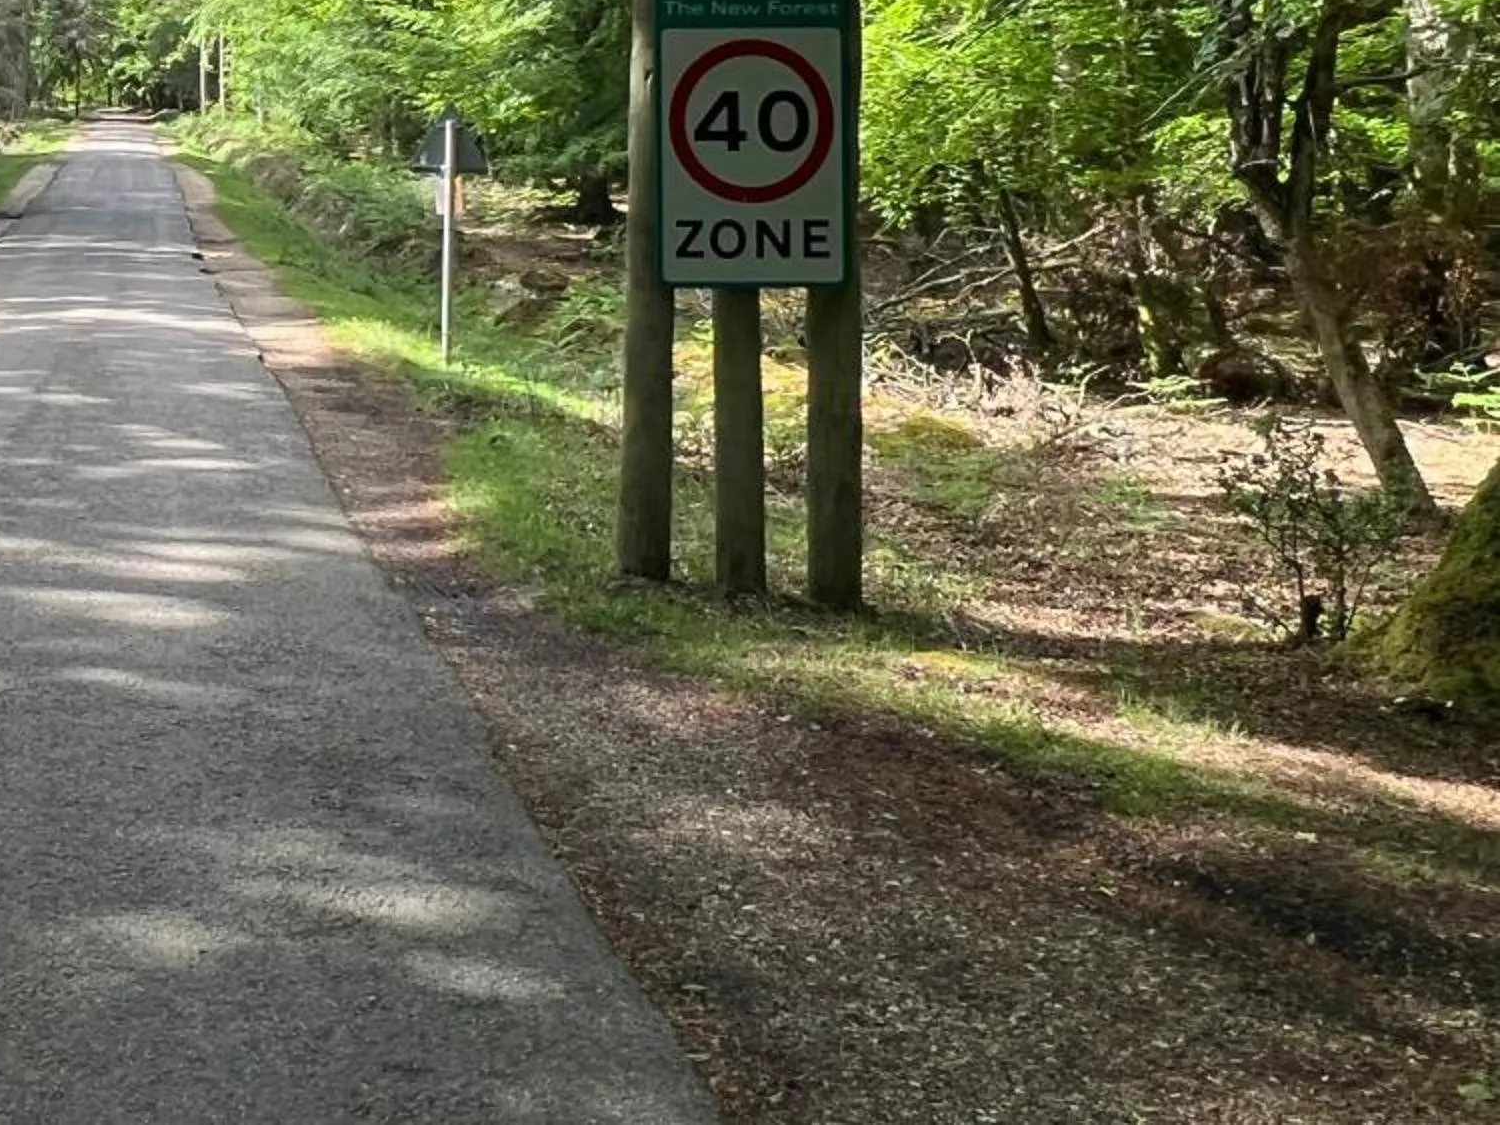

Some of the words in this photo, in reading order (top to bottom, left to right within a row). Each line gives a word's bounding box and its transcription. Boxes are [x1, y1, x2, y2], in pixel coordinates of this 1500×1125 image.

[663, 0, 704, 16] The
[711, 0, 760, 16] New
[768, 0, 839, 16] Forest
[694, 90, 810, 152] 40
[675, 219, 831, 259] ZONE
